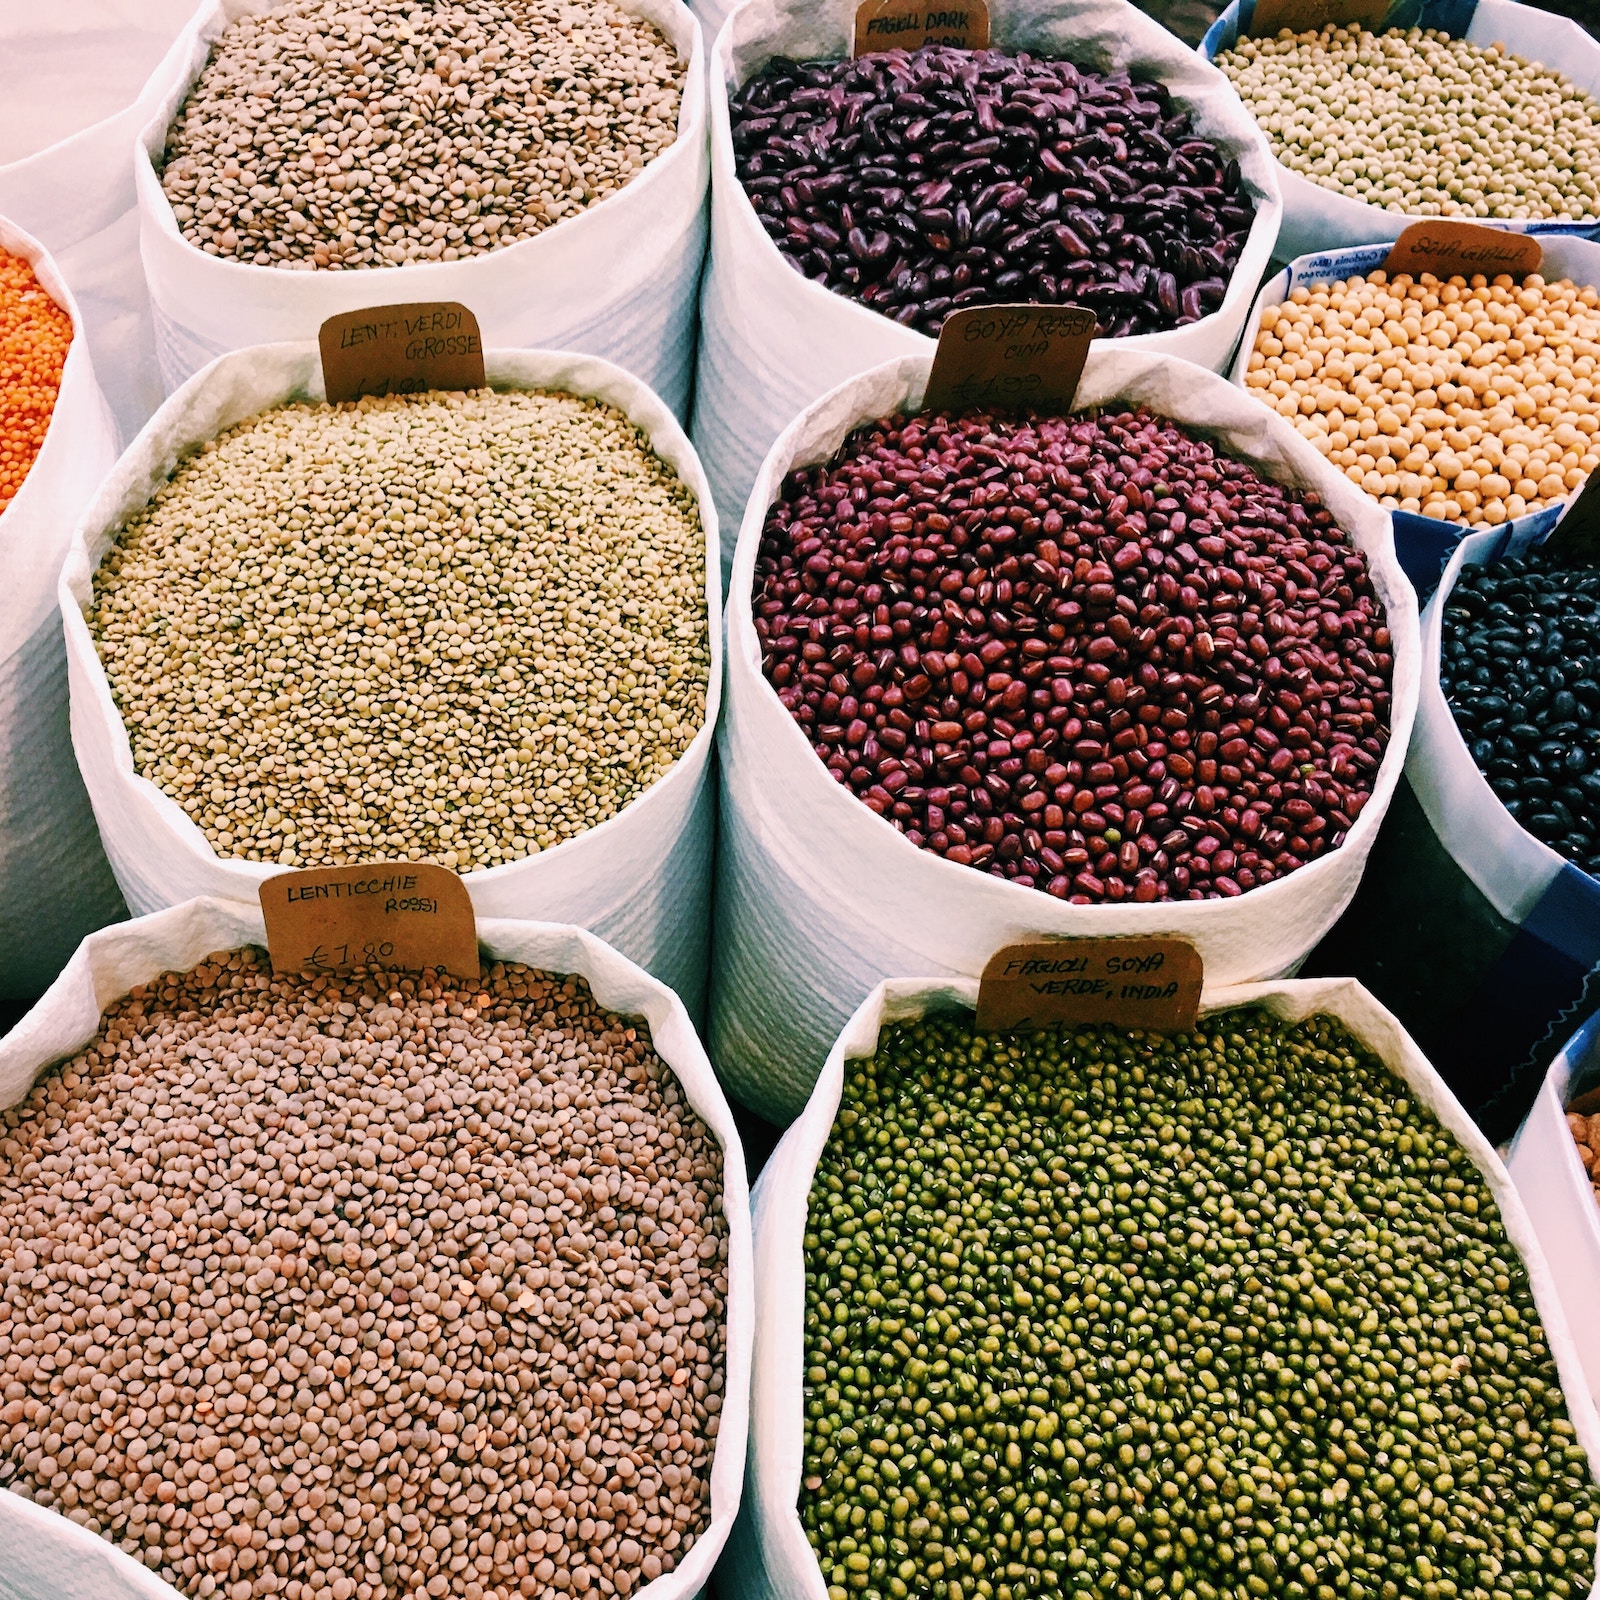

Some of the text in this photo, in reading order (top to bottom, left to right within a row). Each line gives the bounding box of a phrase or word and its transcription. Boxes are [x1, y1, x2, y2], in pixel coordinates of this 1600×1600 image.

[925, 10, 970, 31] DARK
[404, 311, 462, 336] VERDI
[963, 313, 1093, 342] SOYA ROSSI
[405, 335, 481, 360] GROSSE
[1003, 340, 1049, 360] CINA
[286, 874, 418, 903] LENTICCHIE
[384, 897, 438, 914] ROSSI
[1106, 952, 1165, 975] SOYA
[1119, 981, 1179, 1000] INDIA
